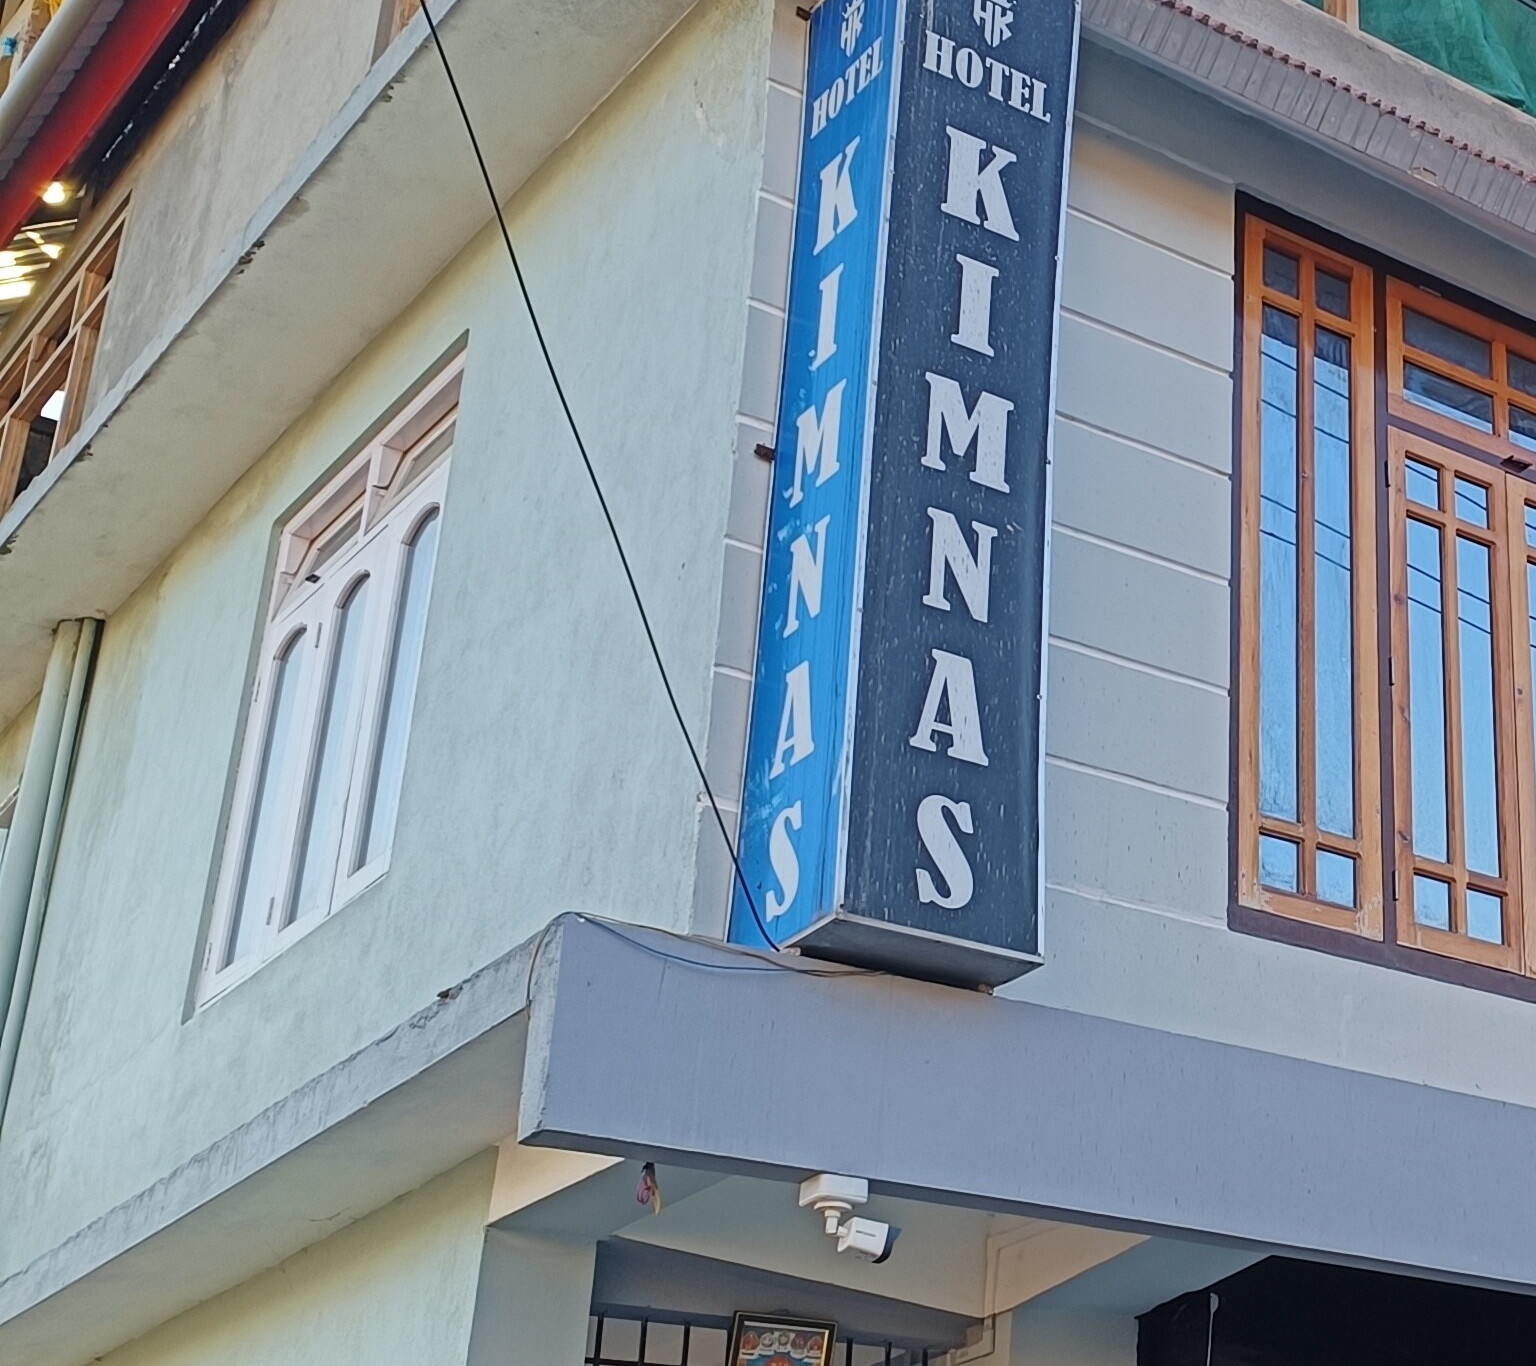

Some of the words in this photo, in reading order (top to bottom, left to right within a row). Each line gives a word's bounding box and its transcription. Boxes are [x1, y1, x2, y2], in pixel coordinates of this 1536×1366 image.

[810, 37, 884, 139] HOTEL
[923, 30, 1051, 123] HOTEL
[765, 136, 861, 922] KIMNAS
[908, 125, 1021, 910] KIMNAS
